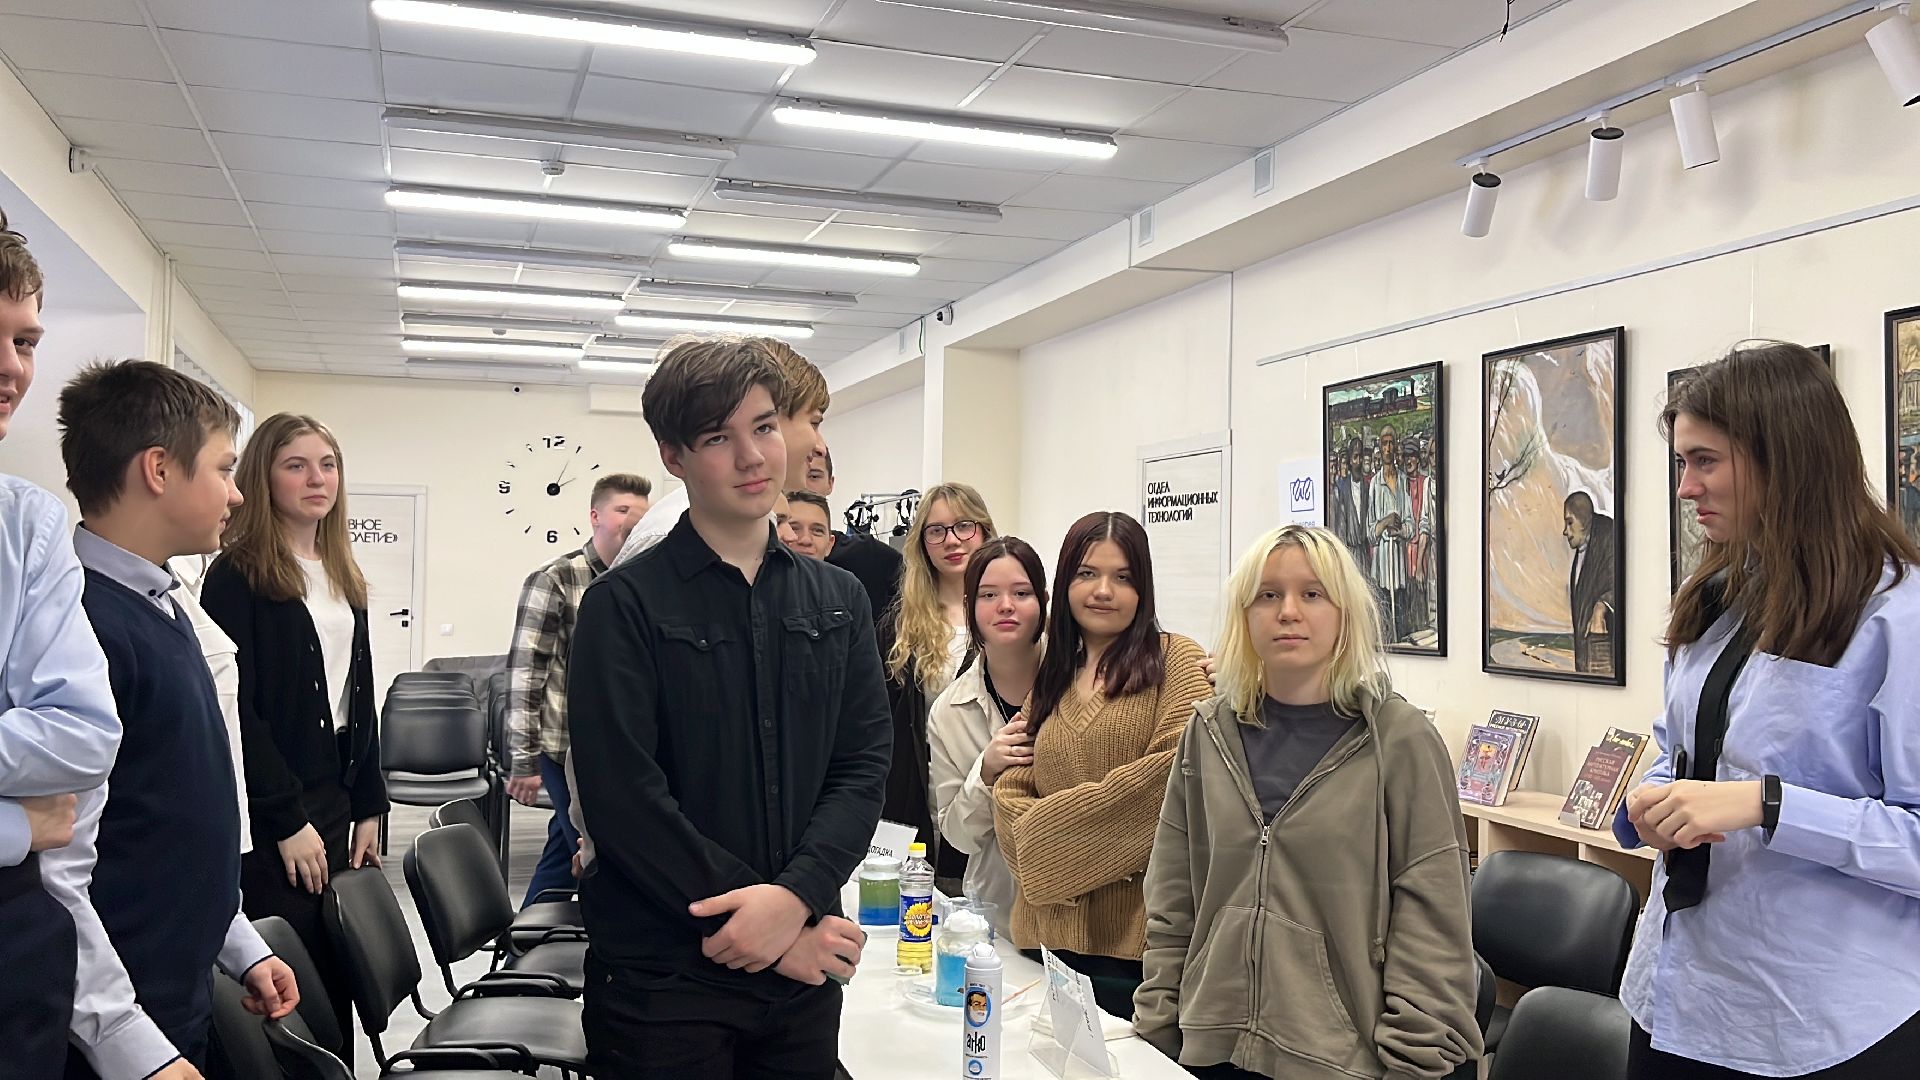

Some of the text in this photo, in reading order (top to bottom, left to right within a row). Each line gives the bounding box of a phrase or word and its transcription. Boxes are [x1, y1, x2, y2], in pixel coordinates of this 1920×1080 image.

[542, 436, 566, 448] 12
[1147, 481, 1170, 495] ОТДЕЛ
[1147, 491, 1219, 508] ИНФОРМАЦИОННЫХ
[1147, 507, 1193, 524] ТЕХНОЛОГИЙ
[348, 518, 382, 531] ВНОЕ
[350, 531, 399, 544] ОЛЕТИЕ»
[546, 530, 558, 543] 6
